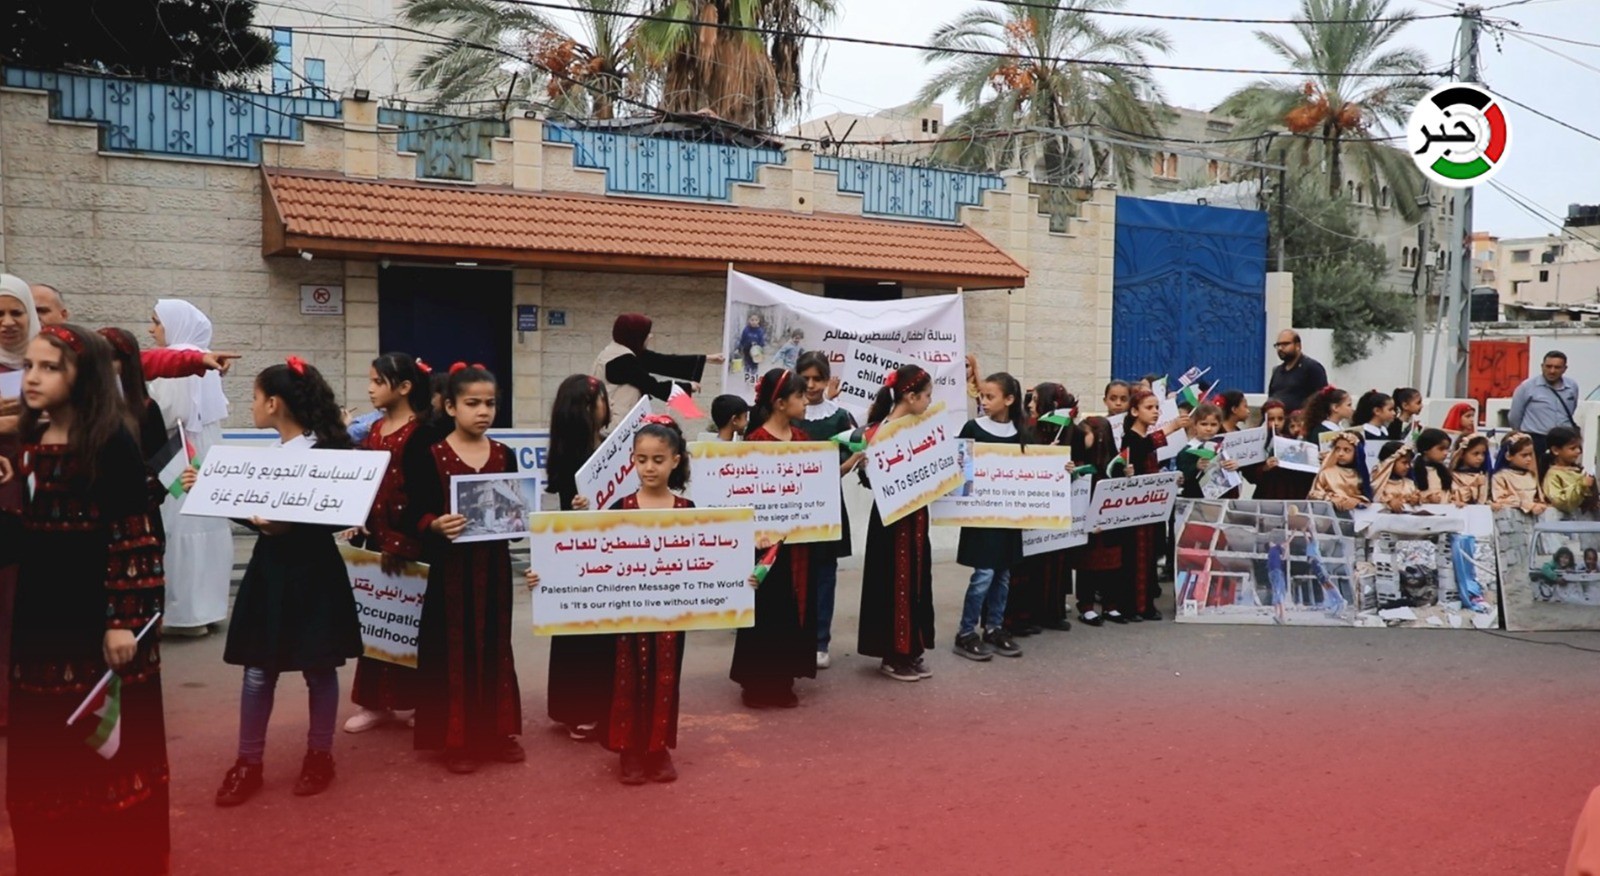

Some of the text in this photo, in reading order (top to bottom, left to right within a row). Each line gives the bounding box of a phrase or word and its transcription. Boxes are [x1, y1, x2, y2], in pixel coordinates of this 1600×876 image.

[823, 327, 957, 344] رسالة أطفال فلسطين للعالم
[854, 349, 878, 365] Look
[841, 381, 866, 399] Gaza
[874, 424, 945, 473] لا لحصار غزة
[203, 460, 377, 483] لا لسياسة التجويع والحرمان
[718, 463, 759, 479] ينادونكم
[777, 462, 794, 478] غزة
[796, 460, 823, 477] أطفال
[881, 455, 955, 498] No To SIEGE Of Gaza
[1014, 469, 1035, 481] نعيش
[1036, 470, 1054, 480] حقنا
[1055, 472, 1065, 482] من
[726, 480, 803, 498] ارفعوا عنا الحصار
[992, 488, 1001, 496] to
[1002, 488, 1016, 497] live
[1017, 488, 1026, 497] in
[1027, 488, 1050, 498] peace
[1051, 489, 1066, 498] like
[210, 488, 344, 512] بحق أطفال قطاع غزة
[780, 501, 803, 511] calling
[804, 500, 815, 508] out
[816, 500, 826, 508] for
[970, 500, 1004, 508] children
[1005, 500, 1013, 508] in
[1014, 500, 1028, 508] the
[1029, 501, 1051, 509] world
[757, 514, 770, 522] the
[770, 512, 789, 523] siege
[790, 512, 799, 520] off
[555, 532, 739, 554] رسالة أطفال فلسطين للعالم
[616, 562, 647, 577] بدون
[649, 557, 683, 576] نعيش
[541, 580, 744, 594] Palestinian Children Message To The World
[560, 601, 568, 609] is
[590, 601, 606, 609] our
[608, 600, 631, 610] right
[644, 598, 661, 607] live
[663, 597, 698, 606] without
